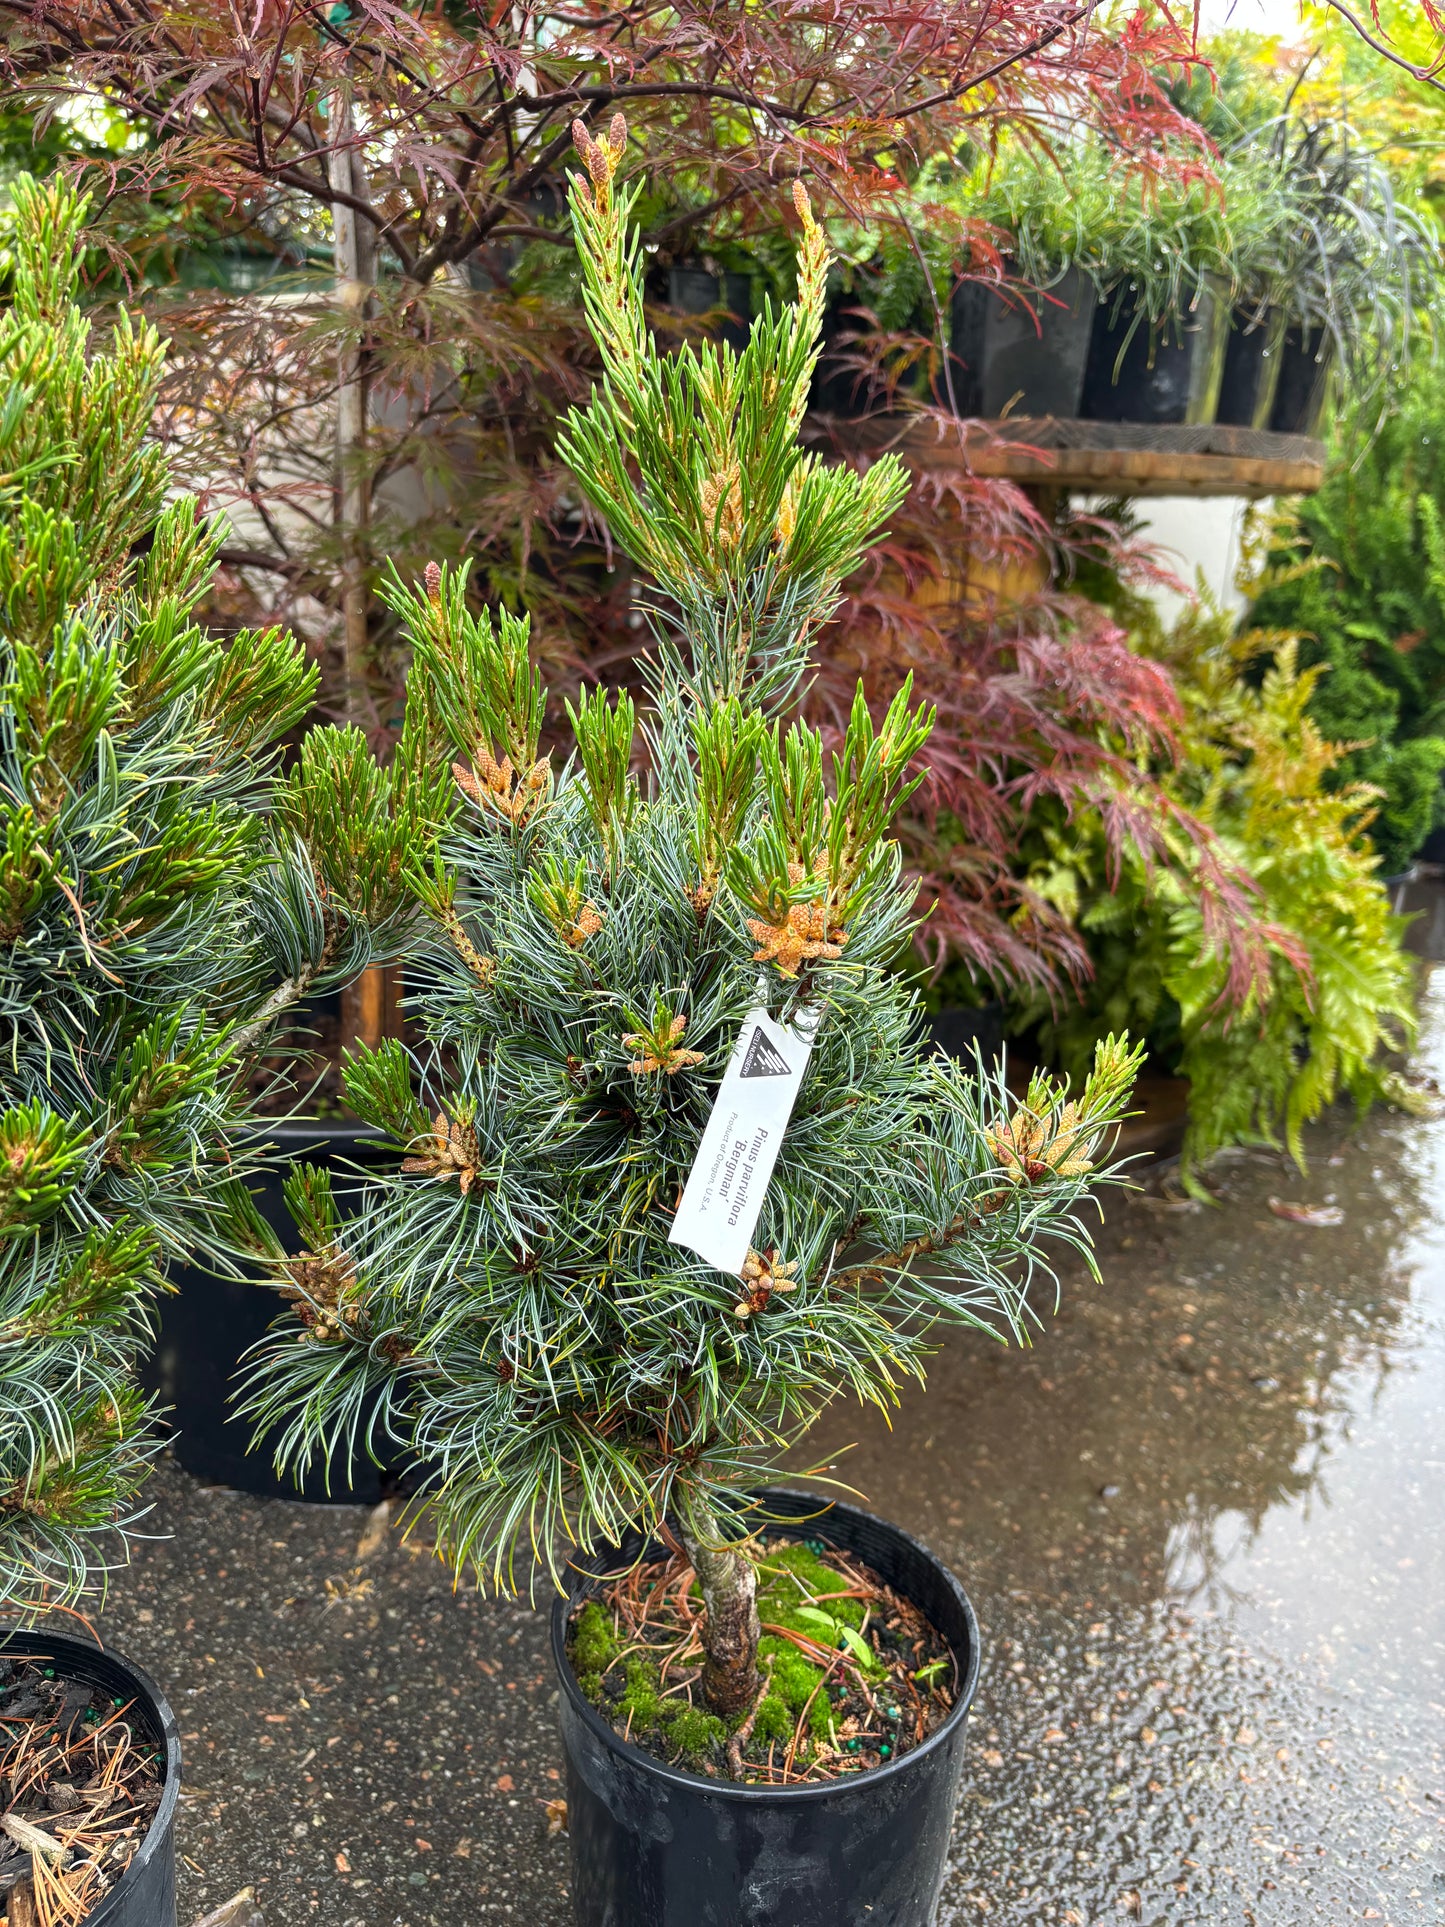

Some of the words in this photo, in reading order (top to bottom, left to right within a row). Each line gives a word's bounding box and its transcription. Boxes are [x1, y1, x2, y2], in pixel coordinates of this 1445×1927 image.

[752, 1028, 762, 1046] ISELI
[742, 1045, 757, 1077] NURSERY
[720, 1111, 738, 1143] Product
[719, 1143, 727, 1154] of
[748, 1127, 769, 1163] Pinus
[708, 1153, 724, 1185] Oregon,
[699, 1187, 713, 1213] U.S.A.
[727, 1162, 754, 1226] parviflora
